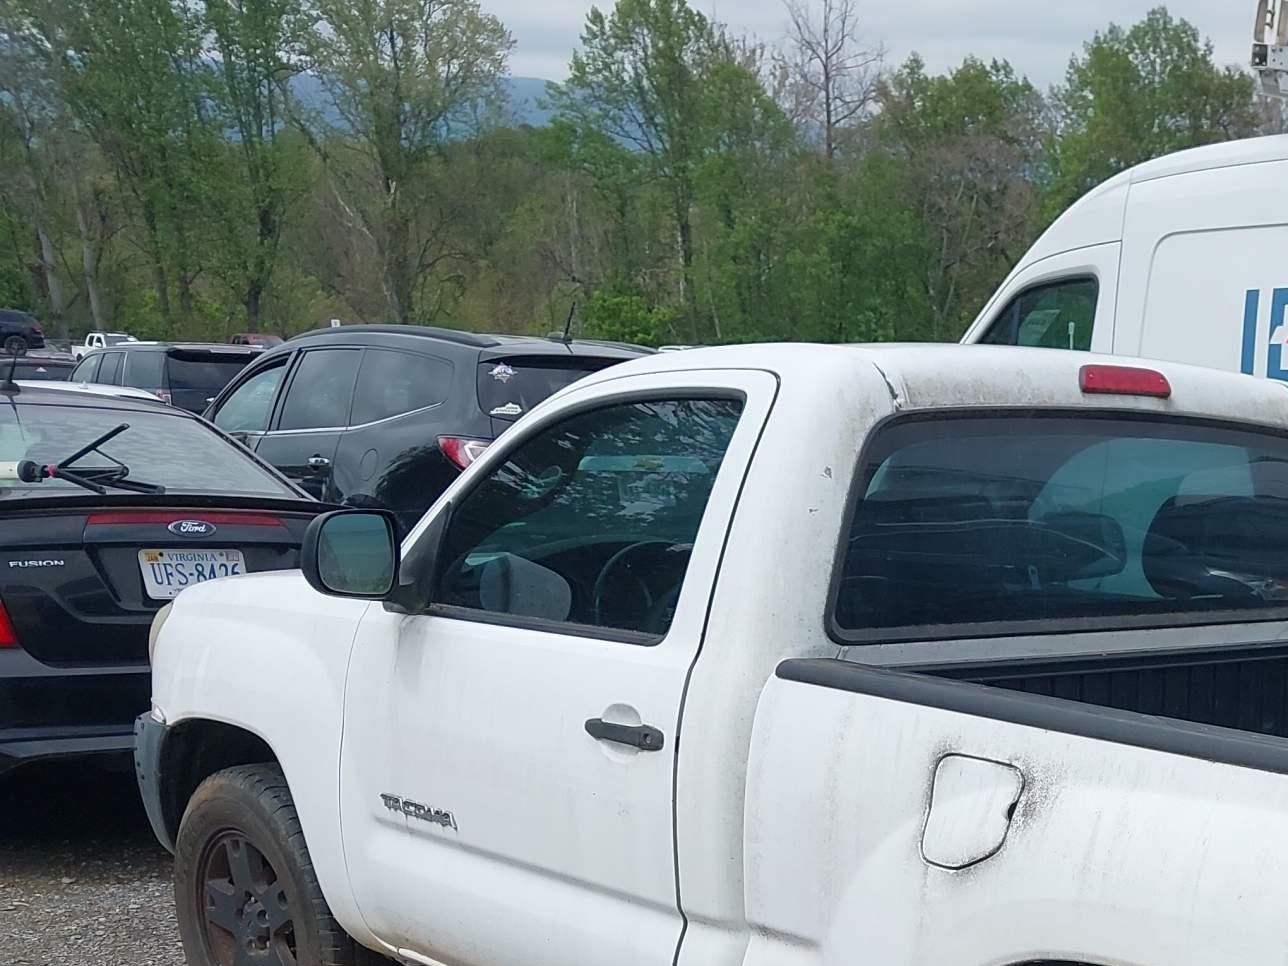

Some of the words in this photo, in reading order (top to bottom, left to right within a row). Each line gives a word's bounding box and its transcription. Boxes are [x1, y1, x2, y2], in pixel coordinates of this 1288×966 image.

[180, 522, 206, 533] Ford
[167, 553, 217, 562] VIRGINIA
[8, 560, 65, 568] FUSION
